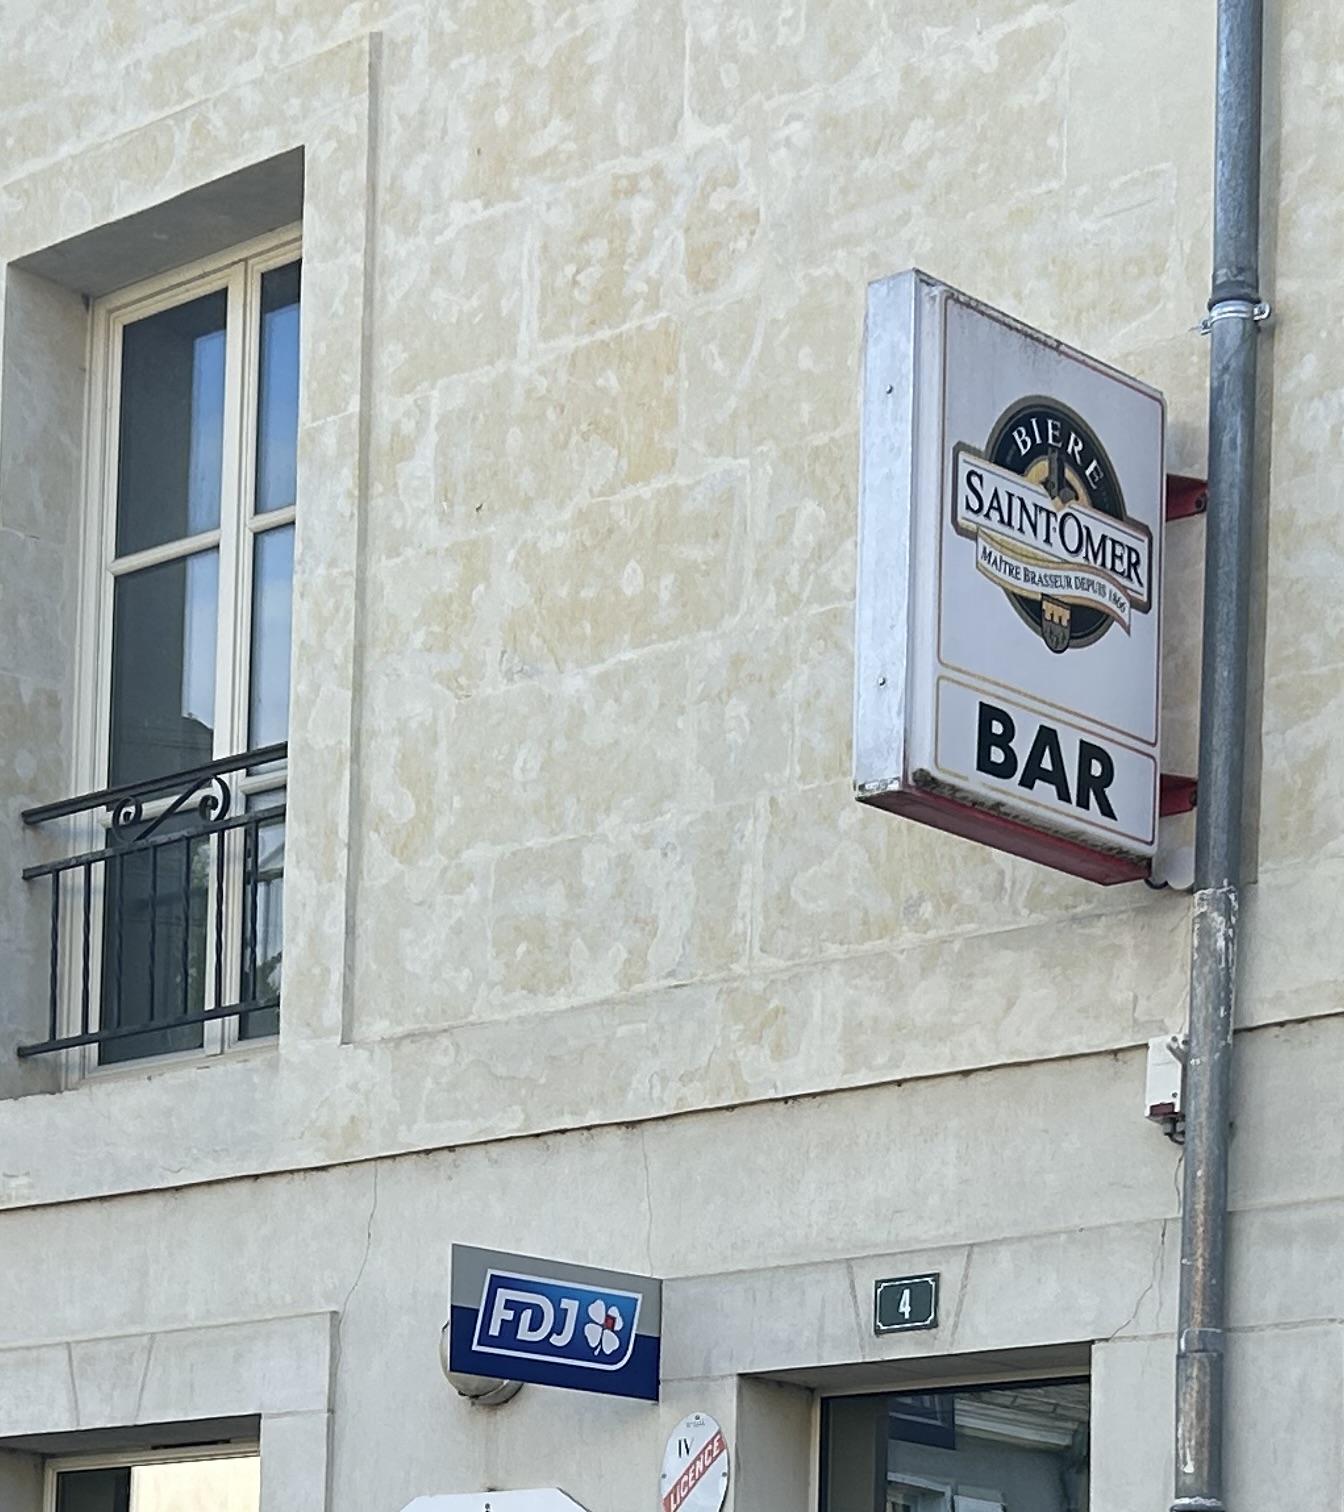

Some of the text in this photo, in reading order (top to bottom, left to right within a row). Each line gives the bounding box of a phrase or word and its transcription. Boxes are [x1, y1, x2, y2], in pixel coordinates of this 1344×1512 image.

[1012, 417, 1105, 490] BIERE
[1022, 566, 1074, 591] BRASSEUR
[1074, 576, 1107, 598] DEPUIS
[976, 700, 1118, 821] BAR
[488, 1287, 579, 1347] FDJ
[898, 1288, 911, 1319] 4
[669, 1433, 722, 1512] LICENCE
[677, 1436, 695, 1458] IV
